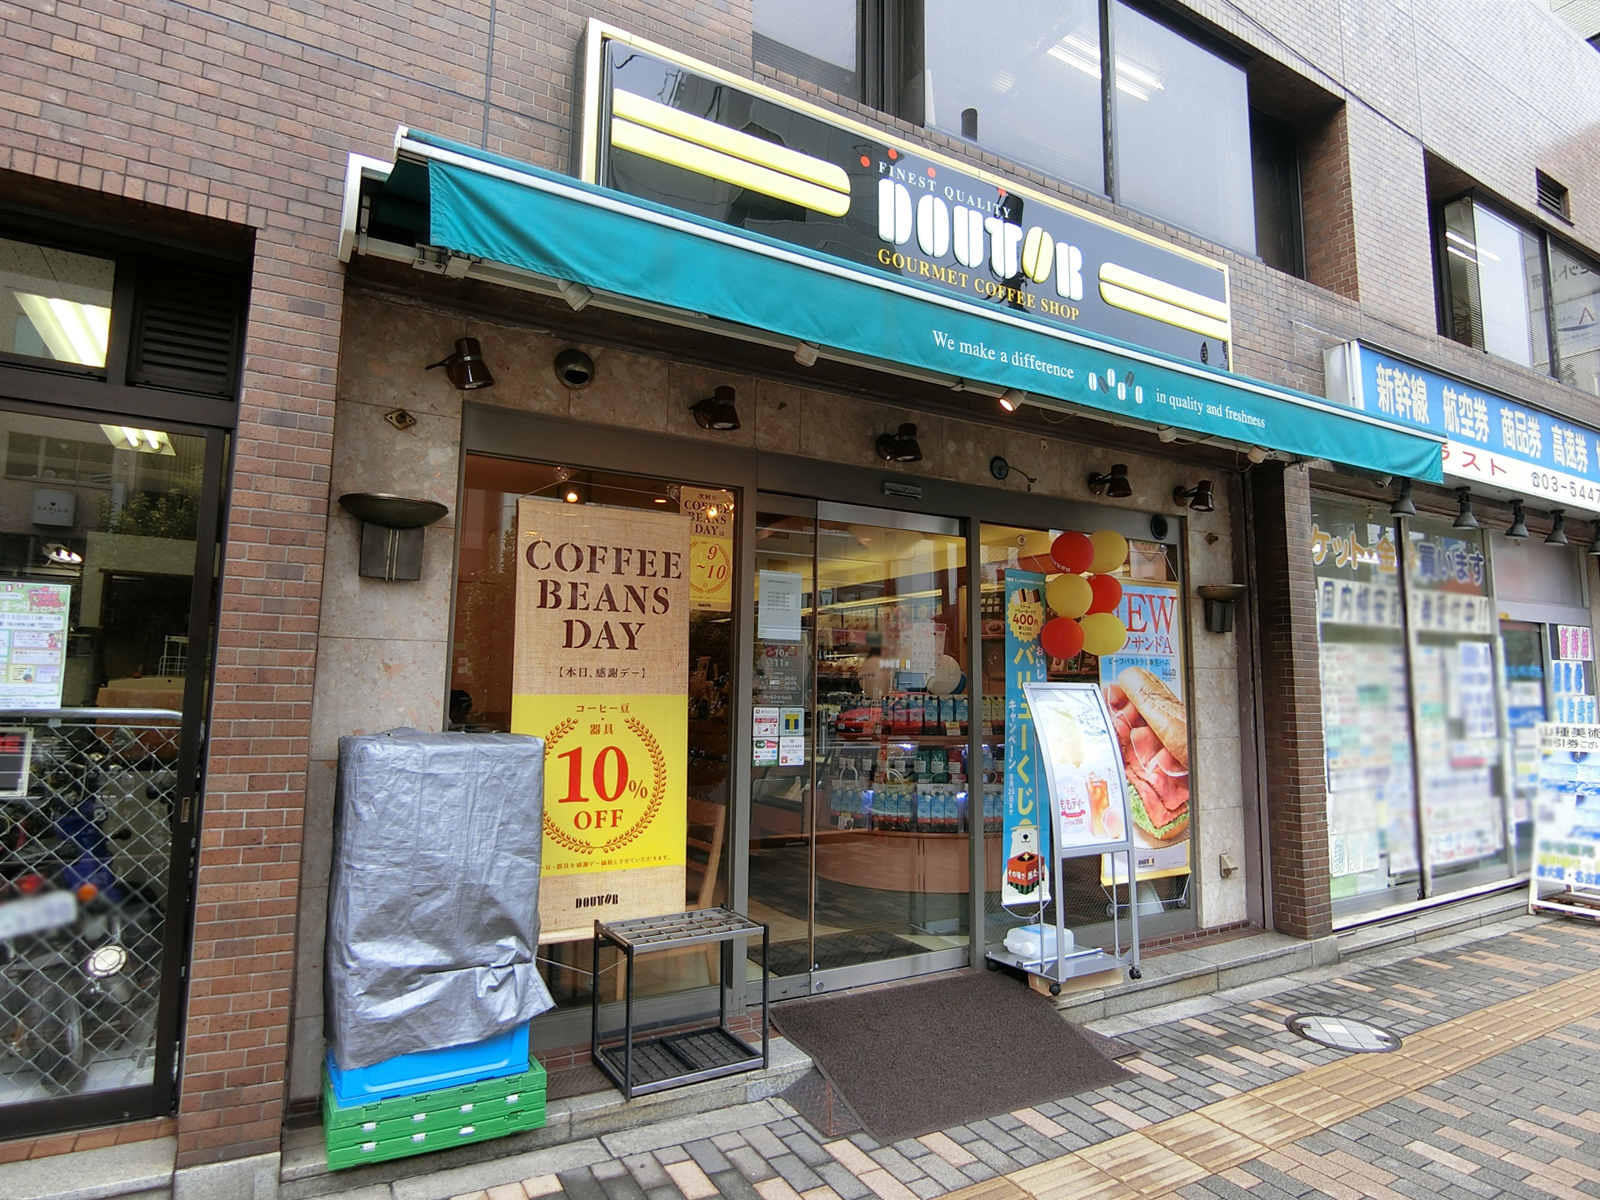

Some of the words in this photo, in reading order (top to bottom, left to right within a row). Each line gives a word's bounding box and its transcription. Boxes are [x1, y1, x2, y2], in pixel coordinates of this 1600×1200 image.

[878, 160, 938, 192] FINEST
[944, 185, 1013, 219] QUALITY
[877, 178, 1084, 301] DOUTOR
[877, 248, 969, 289] GOURMET
[974, 278, 1037, 310] COFFEE
[1040, 297, 1080, 322] SHOP
[932, 329, 956, 352] We
[959, 337, 997, 362] make
[1000, 350, 1008, 364] a
[1011, 350, 1075, 380] difference
[1156, 388, 1167, 403] in
[1169, 394, 1204, 417] quality
[1206, 402, 1223, 418] and
[1224, 404, 1266, 429] freshness
[1375, 362, 1430, 425] 新幹線
[1442, 384, 1490, 443] 航空券
[1500, 405, 1542, 459] 商品券
[1551, 424, 1589, 474] 高速券
[695, 523, 719, 535] DAY
[525, 540, 682, 580] COFFEE
[707, 545, 718, 560] 9
[536, 579, 670, 615] BEANS
[1117, 592, 1178, 635] EW
[561, 618, 646, 651] DAY
[1012, 613, 1039, 627] 400円
[576, 702, 630, 713] コーヒー豆
[590, 723, 614, 735] 器具
[1008, 699, 1017, 770] キャンペーン
[573, 808, 624, 830] OFF
[575, 893, 619, 909] DOUTOR
